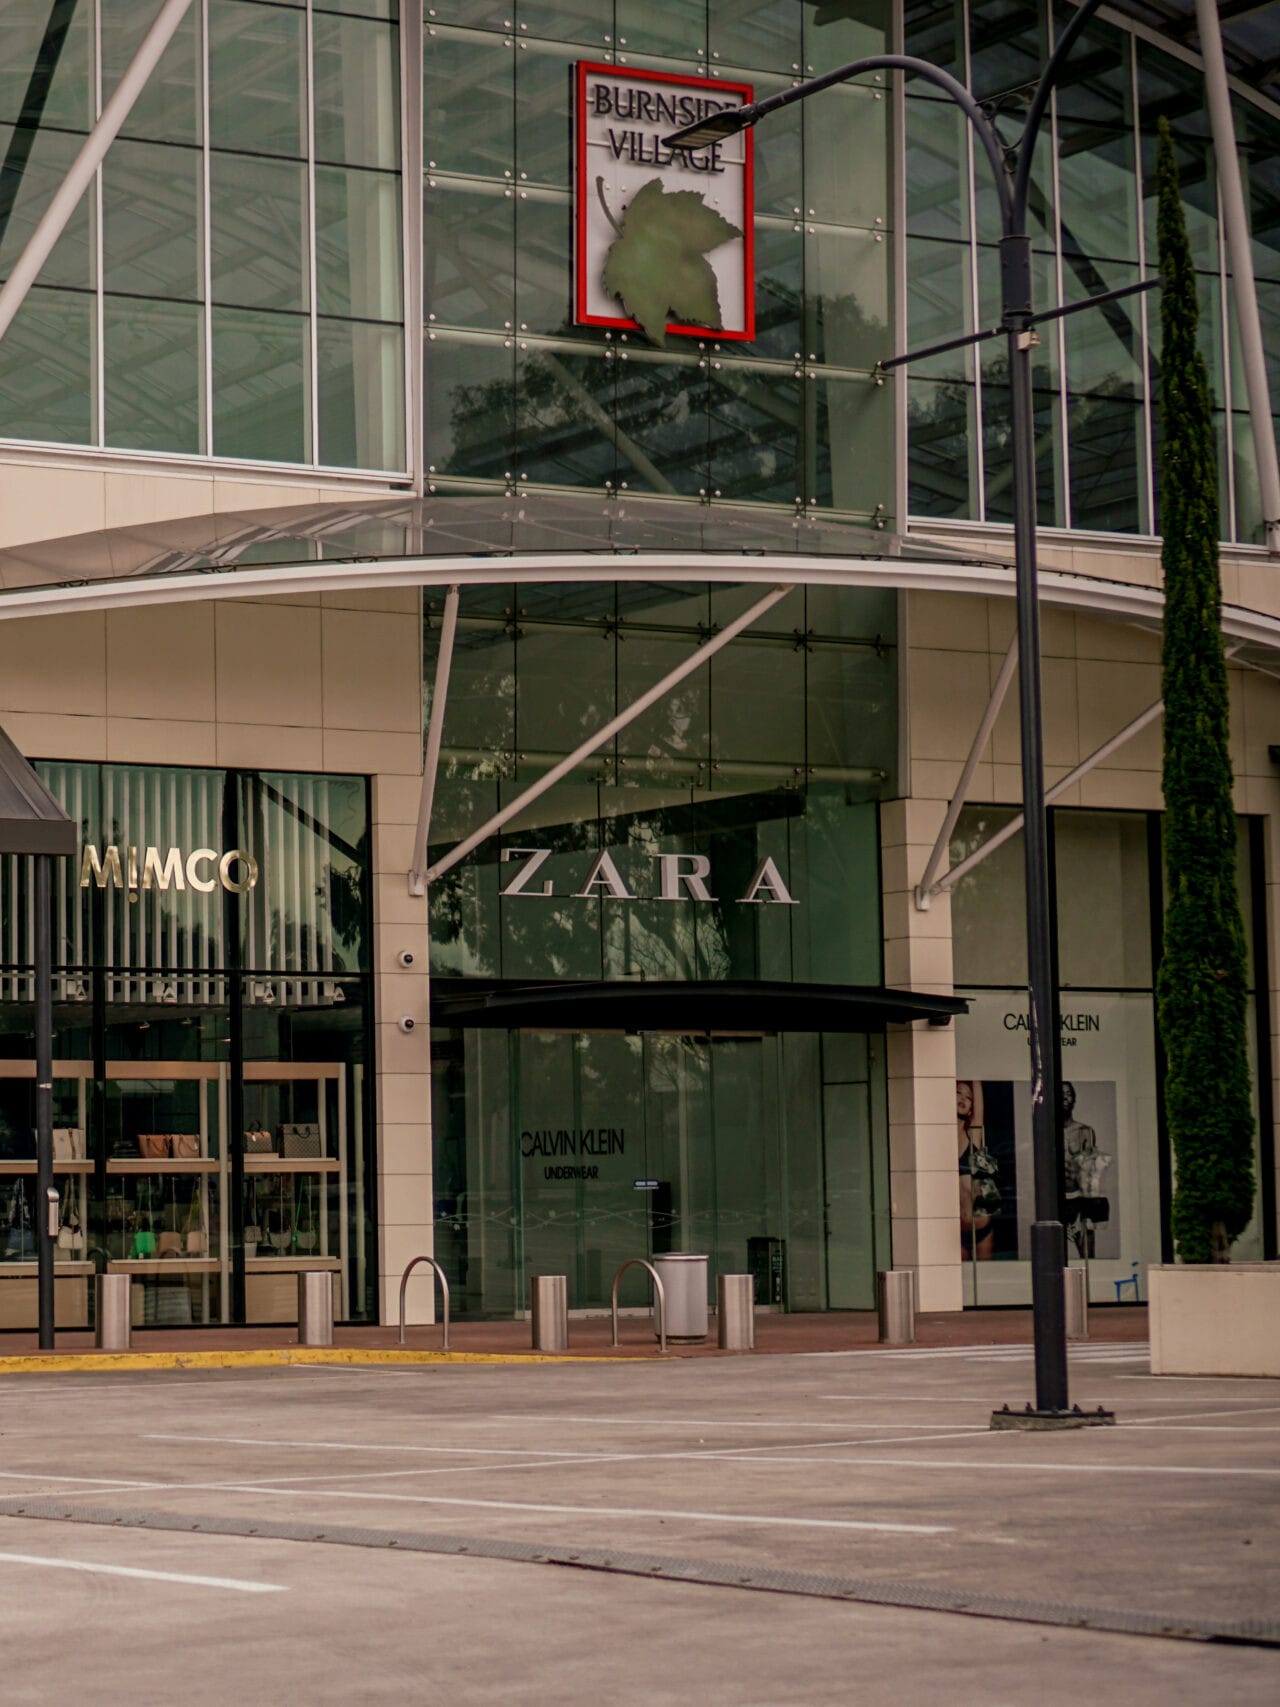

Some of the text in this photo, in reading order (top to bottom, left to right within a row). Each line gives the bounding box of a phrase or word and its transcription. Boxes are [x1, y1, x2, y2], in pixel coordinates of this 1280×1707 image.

[594, 83, 737, 127] BURNSID
[499, 848, 801, 904] ZARA
[1060, 1014, 1100, 1031] KLEIN
[520, 1128, 625, 1157] CALVIN KLEIN
[544, 1166, 598, 1180] UNDERWEAR
